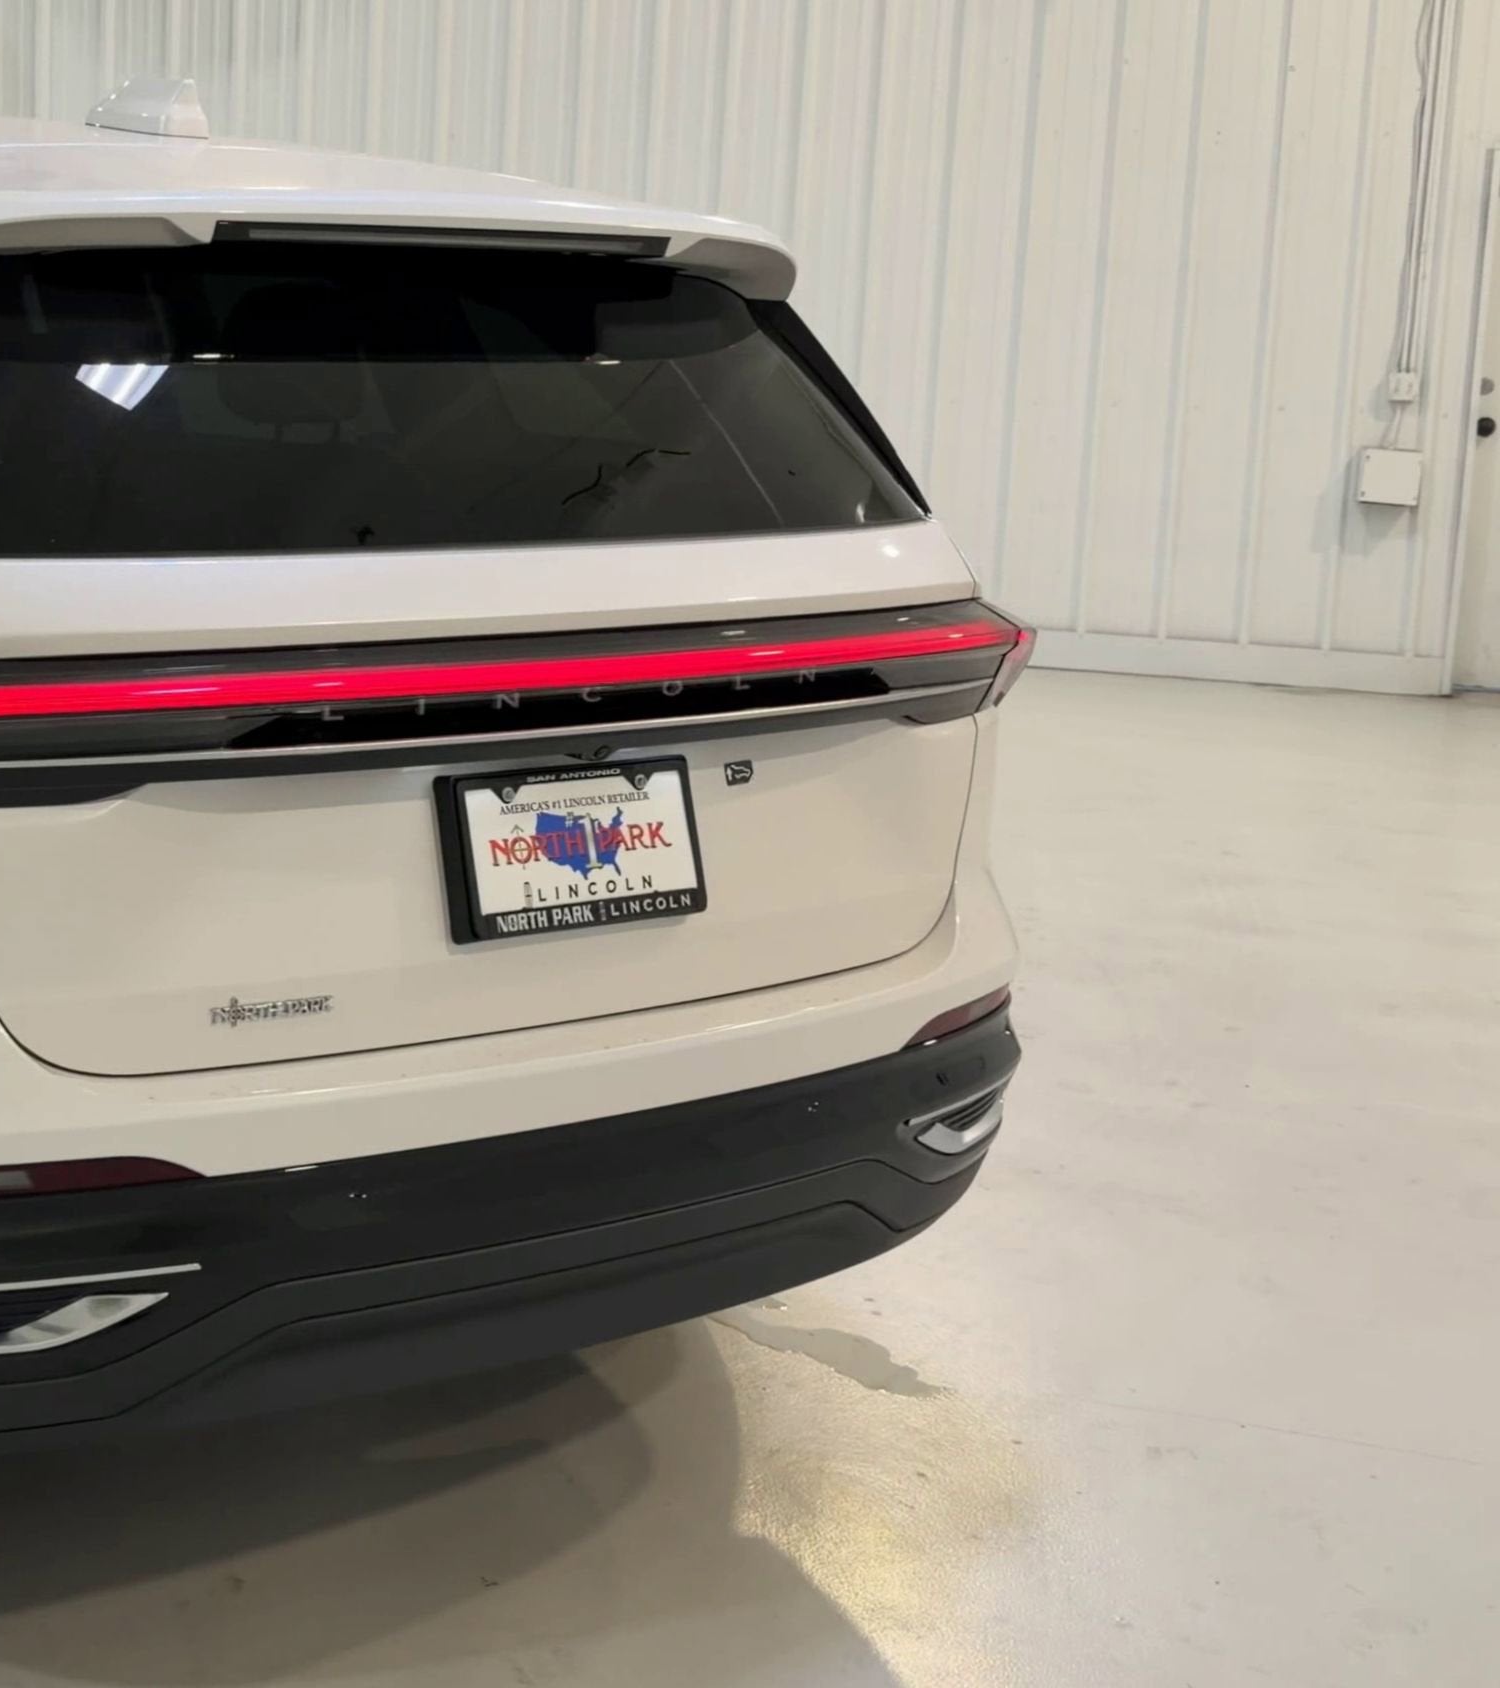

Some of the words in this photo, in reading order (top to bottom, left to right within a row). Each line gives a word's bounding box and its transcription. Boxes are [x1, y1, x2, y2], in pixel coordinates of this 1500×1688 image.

[321, 669, 816, 721] LINCOLN
[526, 775, 556, 784] SAN
[560, 768, 621, 780] ANTONIO
[500, 801, 550, 816] AMERICA'S
[552, 799, 562, 810] #1
[564, 796, 607, 809] LINCOLN
[607, 791, 650, 805] RETAILER
[488, 829, 585, 867] NORTH
[599, 821, 672, 853] PARK
[537, 875, 654, 902] LINCOLN
[496, 909, 549, 933] NORTH
[552, 904, 595, 926] PARK
[610, 893, 692, 917] LINCOLN
